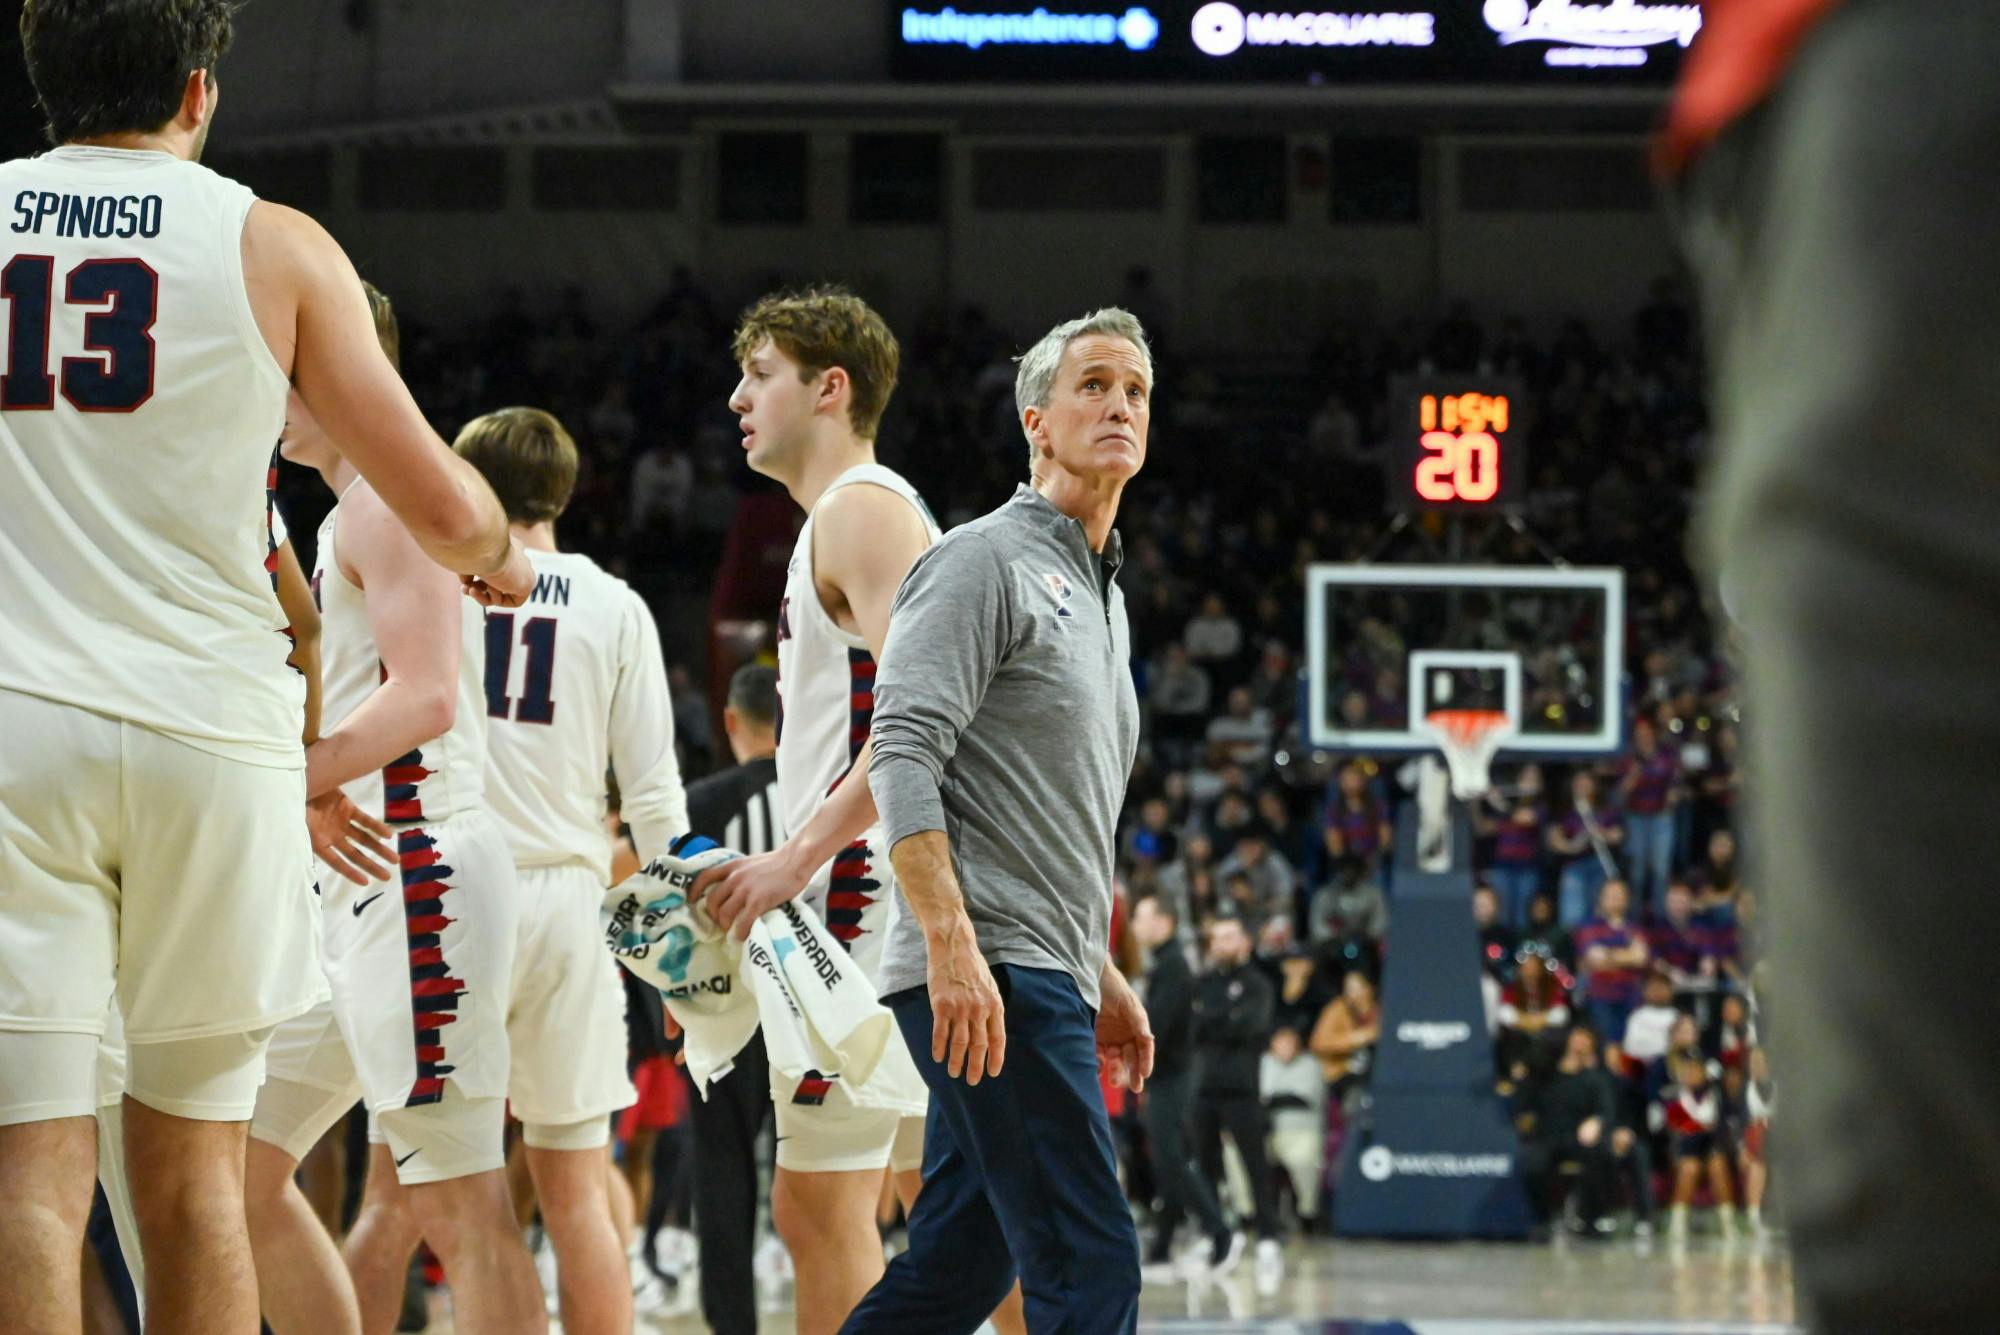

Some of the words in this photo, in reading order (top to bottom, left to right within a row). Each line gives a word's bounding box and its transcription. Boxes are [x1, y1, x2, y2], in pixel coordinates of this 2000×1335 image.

[902, 7, 1116, 49] Independence
[1246, 12, 1435, 46] MACQUARIE
[11, 190, 162, 239] SPINOSO
[0, 253, 159, 413] 13
[1415, 431, 1499, 502] 20
[484, 611, 558, 726] 11
[777, 900, 843, 992] OWERADE
